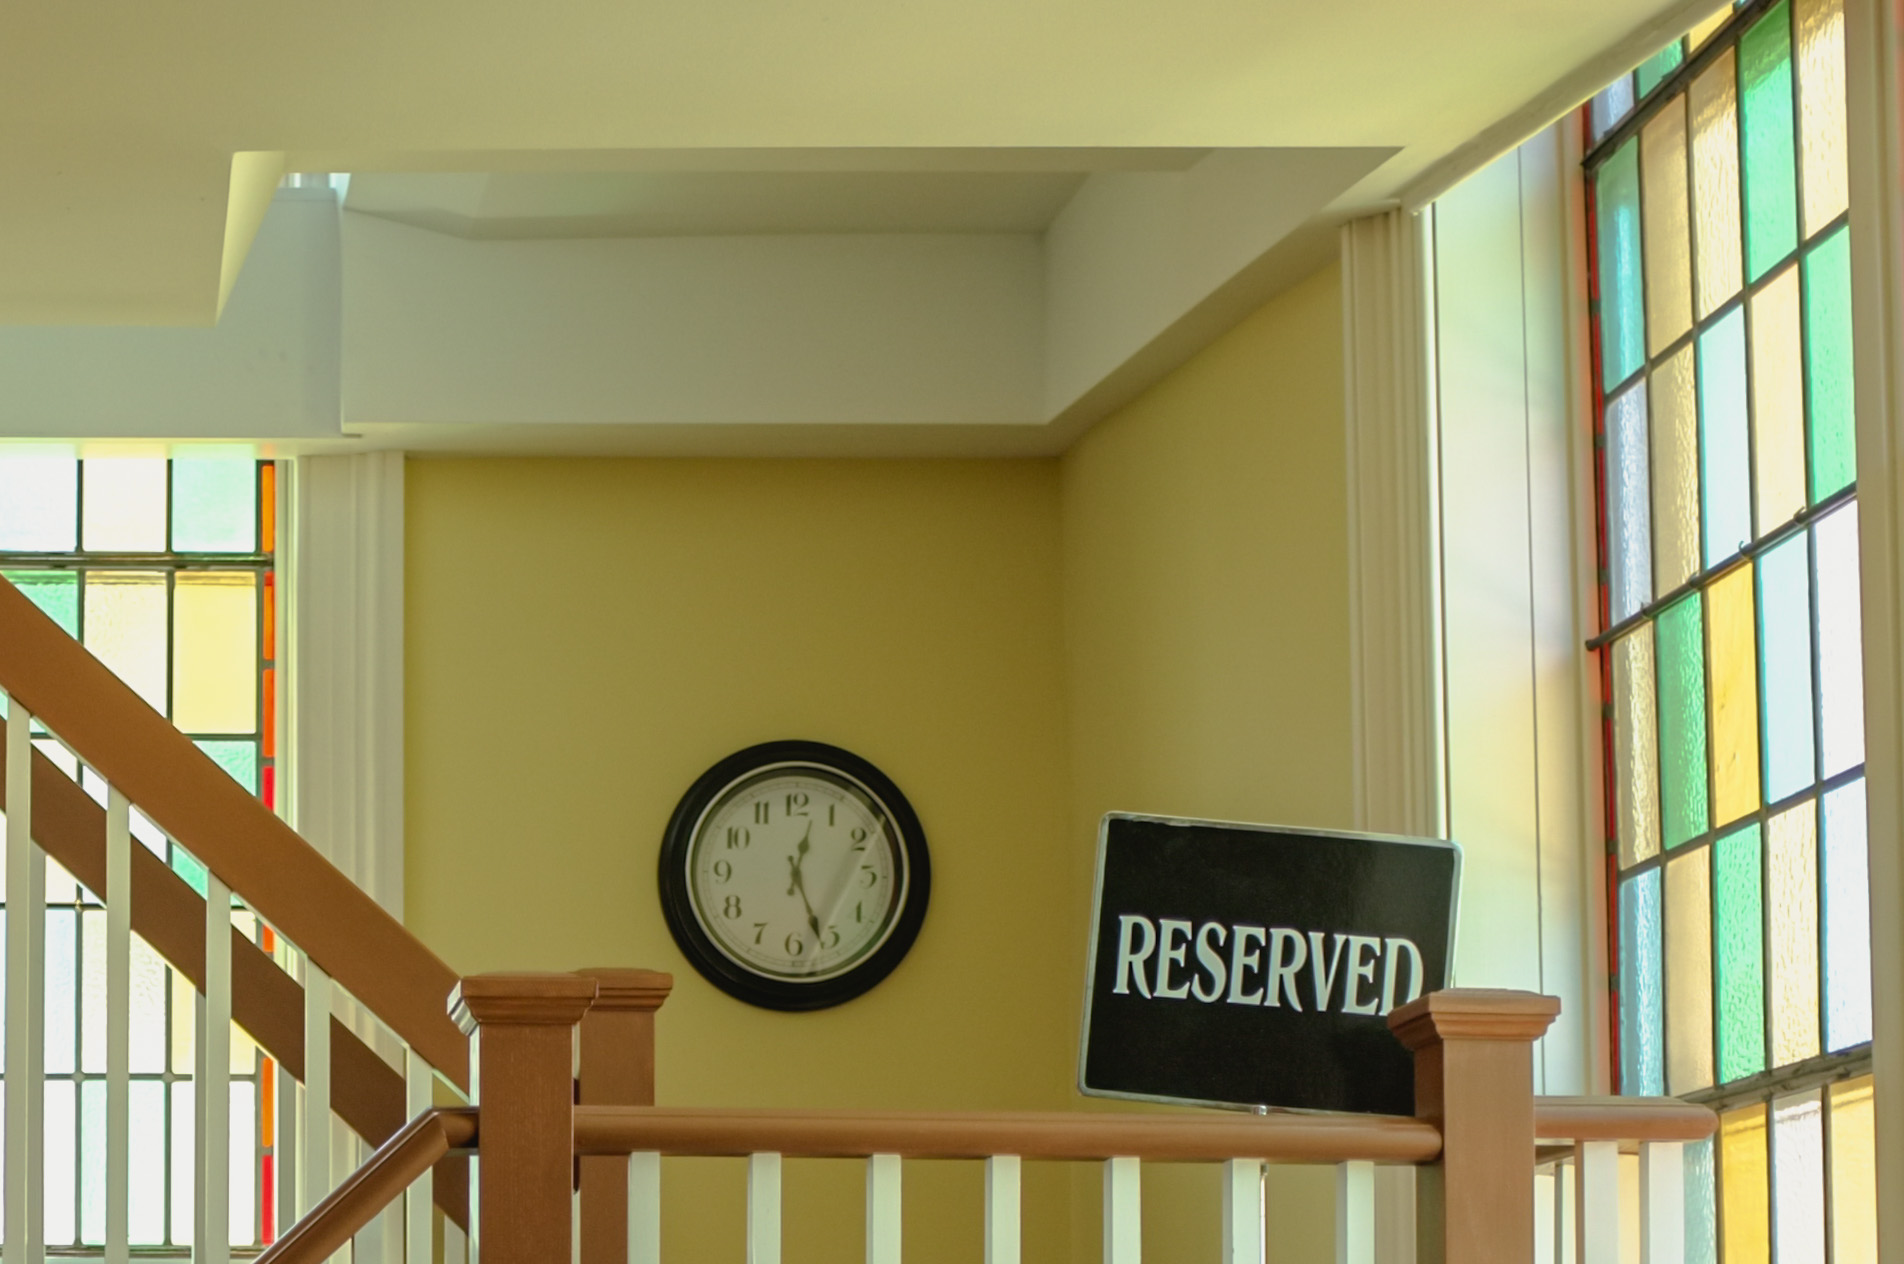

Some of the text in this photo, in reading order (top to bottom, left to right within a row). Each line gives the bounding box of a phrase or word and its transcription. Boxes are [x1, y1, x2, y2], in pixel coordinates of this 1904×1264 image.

[754, 801, 770, 824] 11
[786, 792, 809, 817] 12
[829, 803, 835, 827] 1
[726, 827, 750, 850] 10
[851, 827, 867, 851] 2
[714, 860, 732, 884] 9
[723, 895, 742, 920] 8
[753, 922, 768, 945] 7
[785, 931, 803, 957] 6
[822, 925, 840, 949] 5
[1112, 914, 1424, 1017] RESERVED
